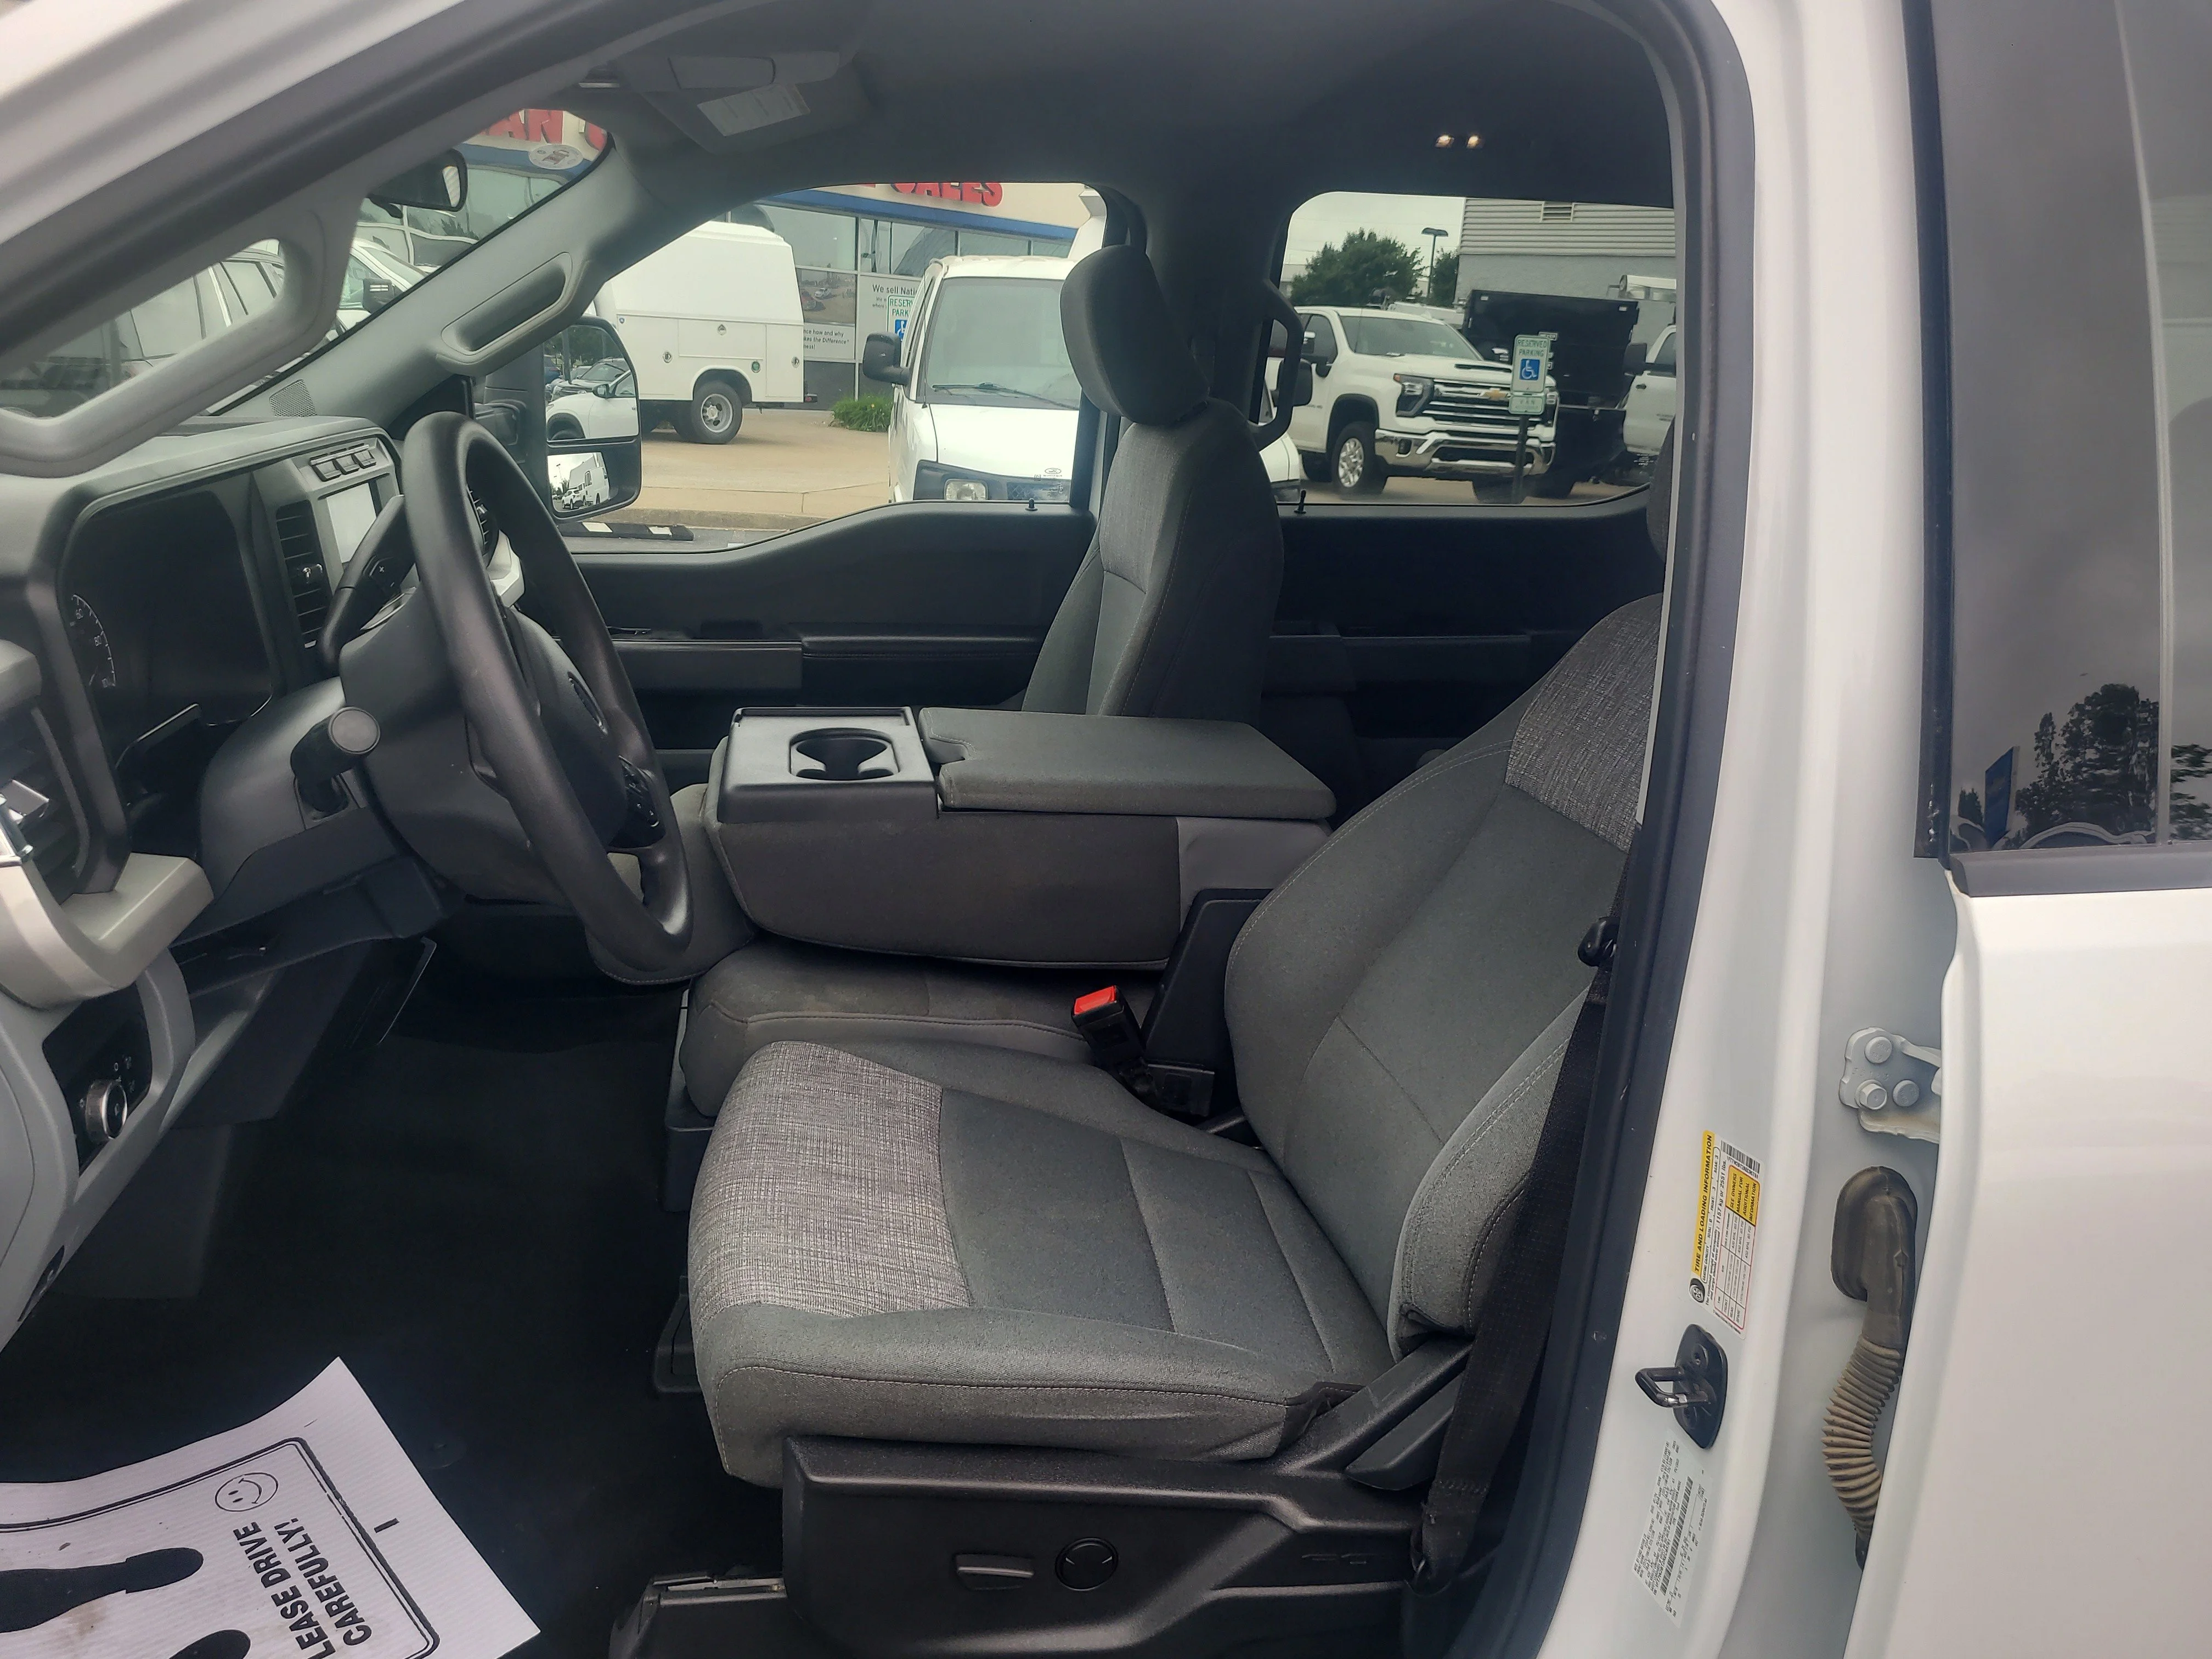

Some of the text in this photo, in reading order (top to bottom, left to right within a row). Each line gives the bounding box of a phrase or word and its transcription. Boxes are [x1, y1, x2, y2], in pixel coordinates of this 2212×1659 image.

[872, 284, 884, 293] We
[887, 286, 899, 294] sell
[892, 308, 910, 318] PARK
[1517, 339, 1547, 348] RESERVED
[1518, 348, 1544, 357] PARKING
[1699, 1195, 1707, 1232] LOADING
[1703, 1135, 1712, 1193] INFORMATION
[1718, 1198, 1723, 1207] kg
[233, 1521, 291, 1588] DRIVE
[274, 1517, 373, 1646] CAREFULLY!
